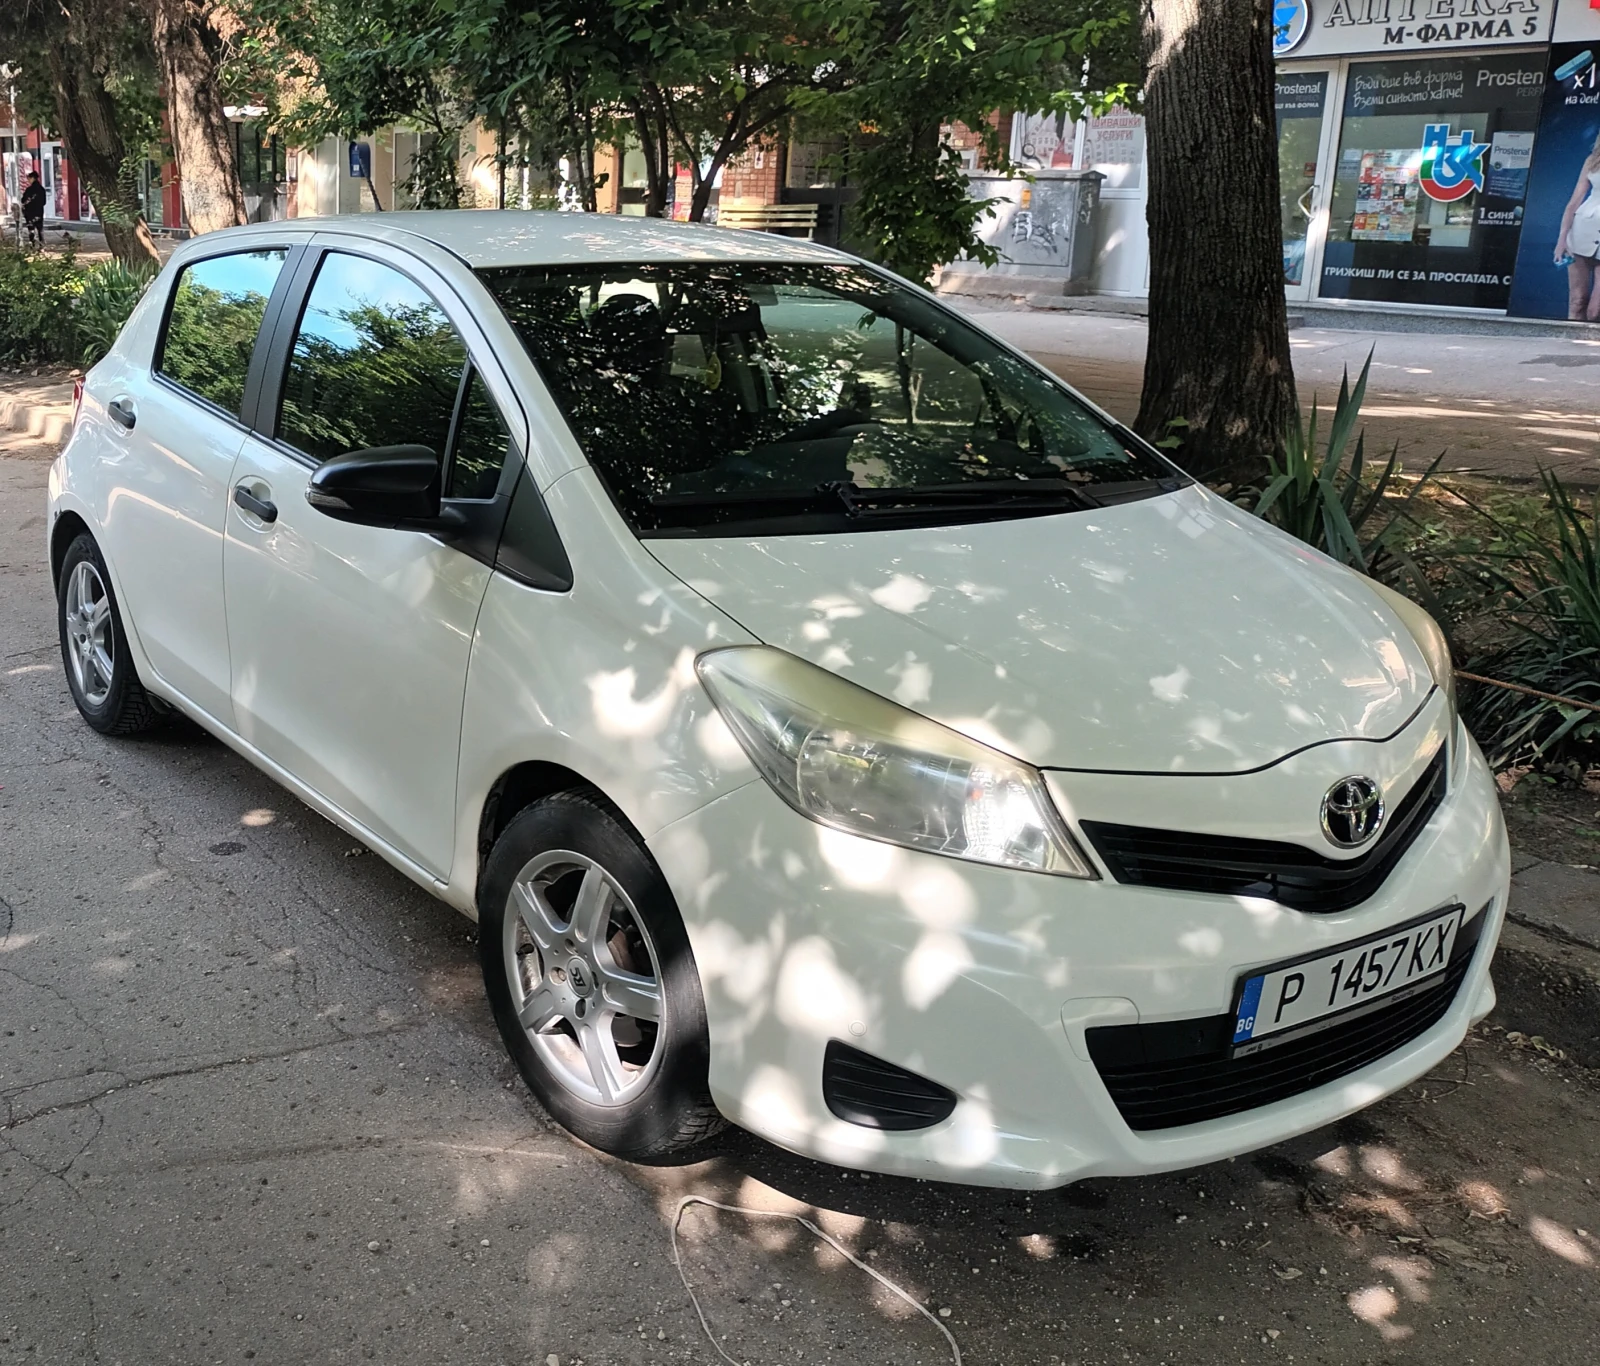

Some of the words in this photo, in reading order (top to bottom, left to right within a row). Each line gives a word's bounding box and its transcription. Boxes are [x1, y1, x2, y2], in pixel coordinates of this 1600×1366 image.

[1383, 19, 1514, 45] М-ФАРМА
[1522, 16, 1538, 36] 5
[1354, 75, 1379, 92] Бъди
[1423, 70, 1463, 91] форма
[1353, 91, 1384, 110] Вземи
[1386, 92, 1428, 105] синьото
[1429, 82, 1464, 101] хапче!
[1516, 86, 1543, 97] PERF
[1565, 95, 1578, 105] на
[1579, 92, 1600, 105] ден!
[1097, 130, 1134, 141] УСЛУГИ
[1494, 145, 1532, 156] Prostenal
[1479, 207, 1486, 219] 1
[1324, 266, 1375, 278] ГРИЖИШ
[1377, 269, 1394, 279] ЛИ
[1397, 270, 1410, 280] СЕ
[1412, 271, 1427, 281] ЗА
[1429, 272, 1499, 285] ПРОСТАТАТА
[1274, 972, 1305, 1023] P
[1236, 1016, 1254, 1034] BG
